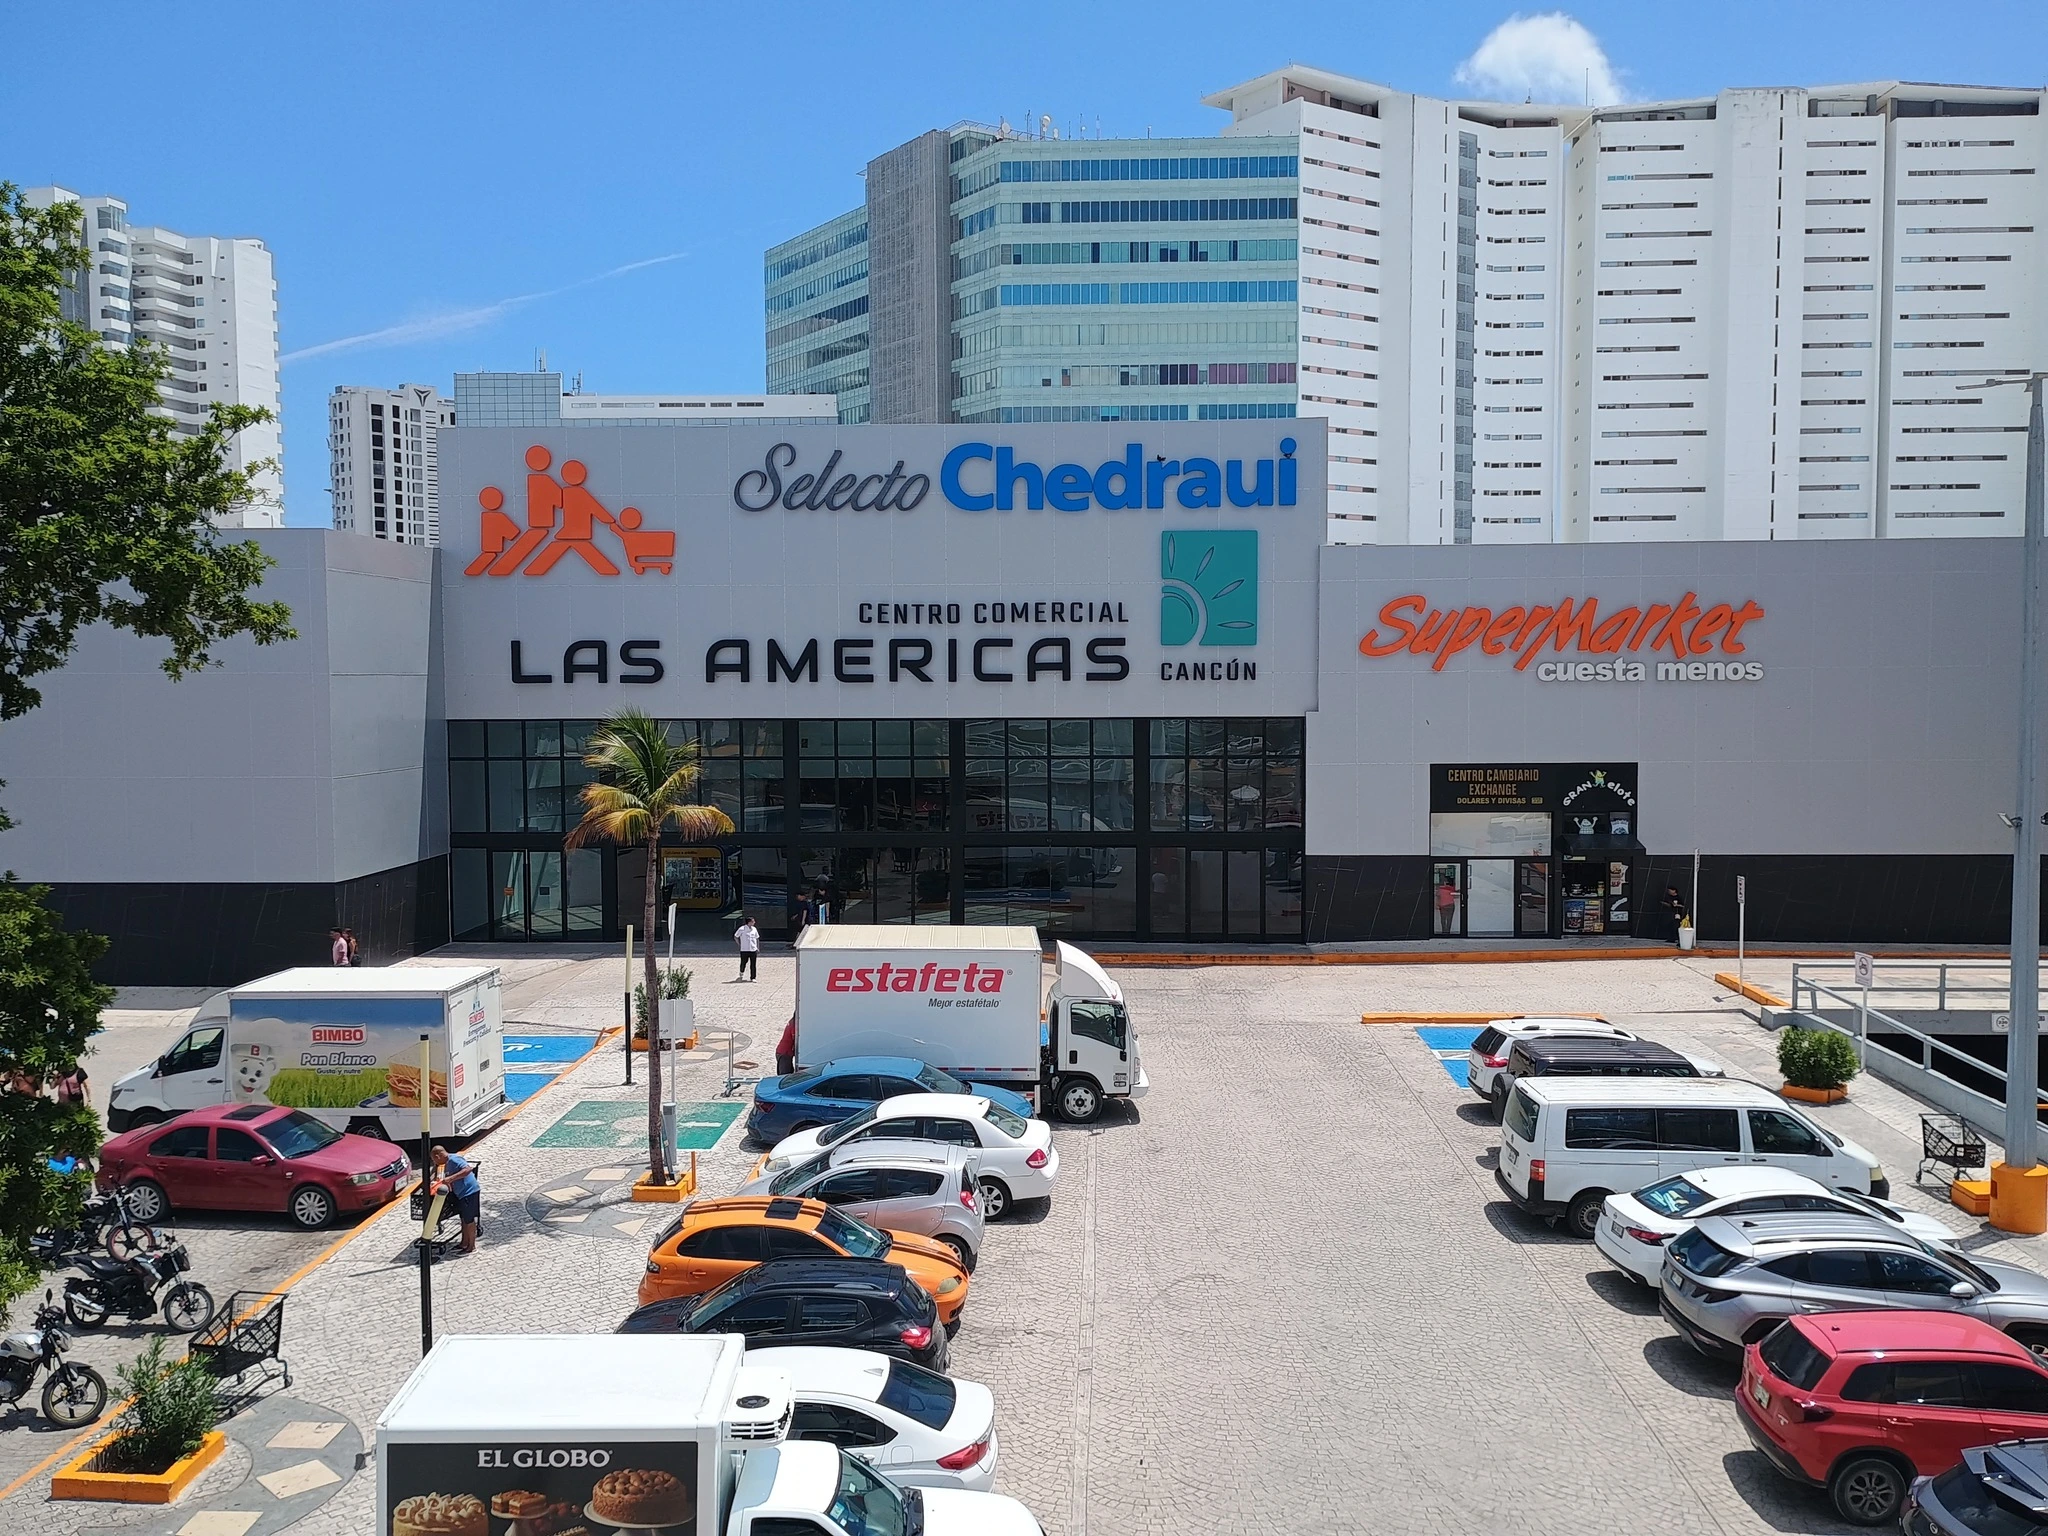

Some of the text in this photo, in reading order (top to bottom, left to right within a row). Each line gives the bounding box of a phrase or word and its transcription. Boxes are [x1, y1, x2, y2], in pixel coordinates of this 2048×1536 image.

[733, 437, 1298, 513] Selecto Chedraui
[859, 602, 1129, 625] CENTRO COMERCIAL
[1359, 591, 1764, 672] SuperMarket
[510, 637, 1130, 685] LAS AMERICAS
[1160, 656, 1258, 683] CANCÚN
[1537, 657, 1764, 682] cuesta menos
[1448, 769, 1539, 781] CENTRO CAMBIARIO
[1469, 783, 1517, 796] EXCHANGE
[1562, 780, 1636, 807] GRAN elote
[826, 962, 1004, 994] estafeta
[928, 997, 1000, 1010] Mejor estafétalo
[312, 1029, 364, 1042] BIMBO
[301, 1051, 377, 1066] Pan Blanco
[477, 1449, 611, 1468] EL GLOBO
